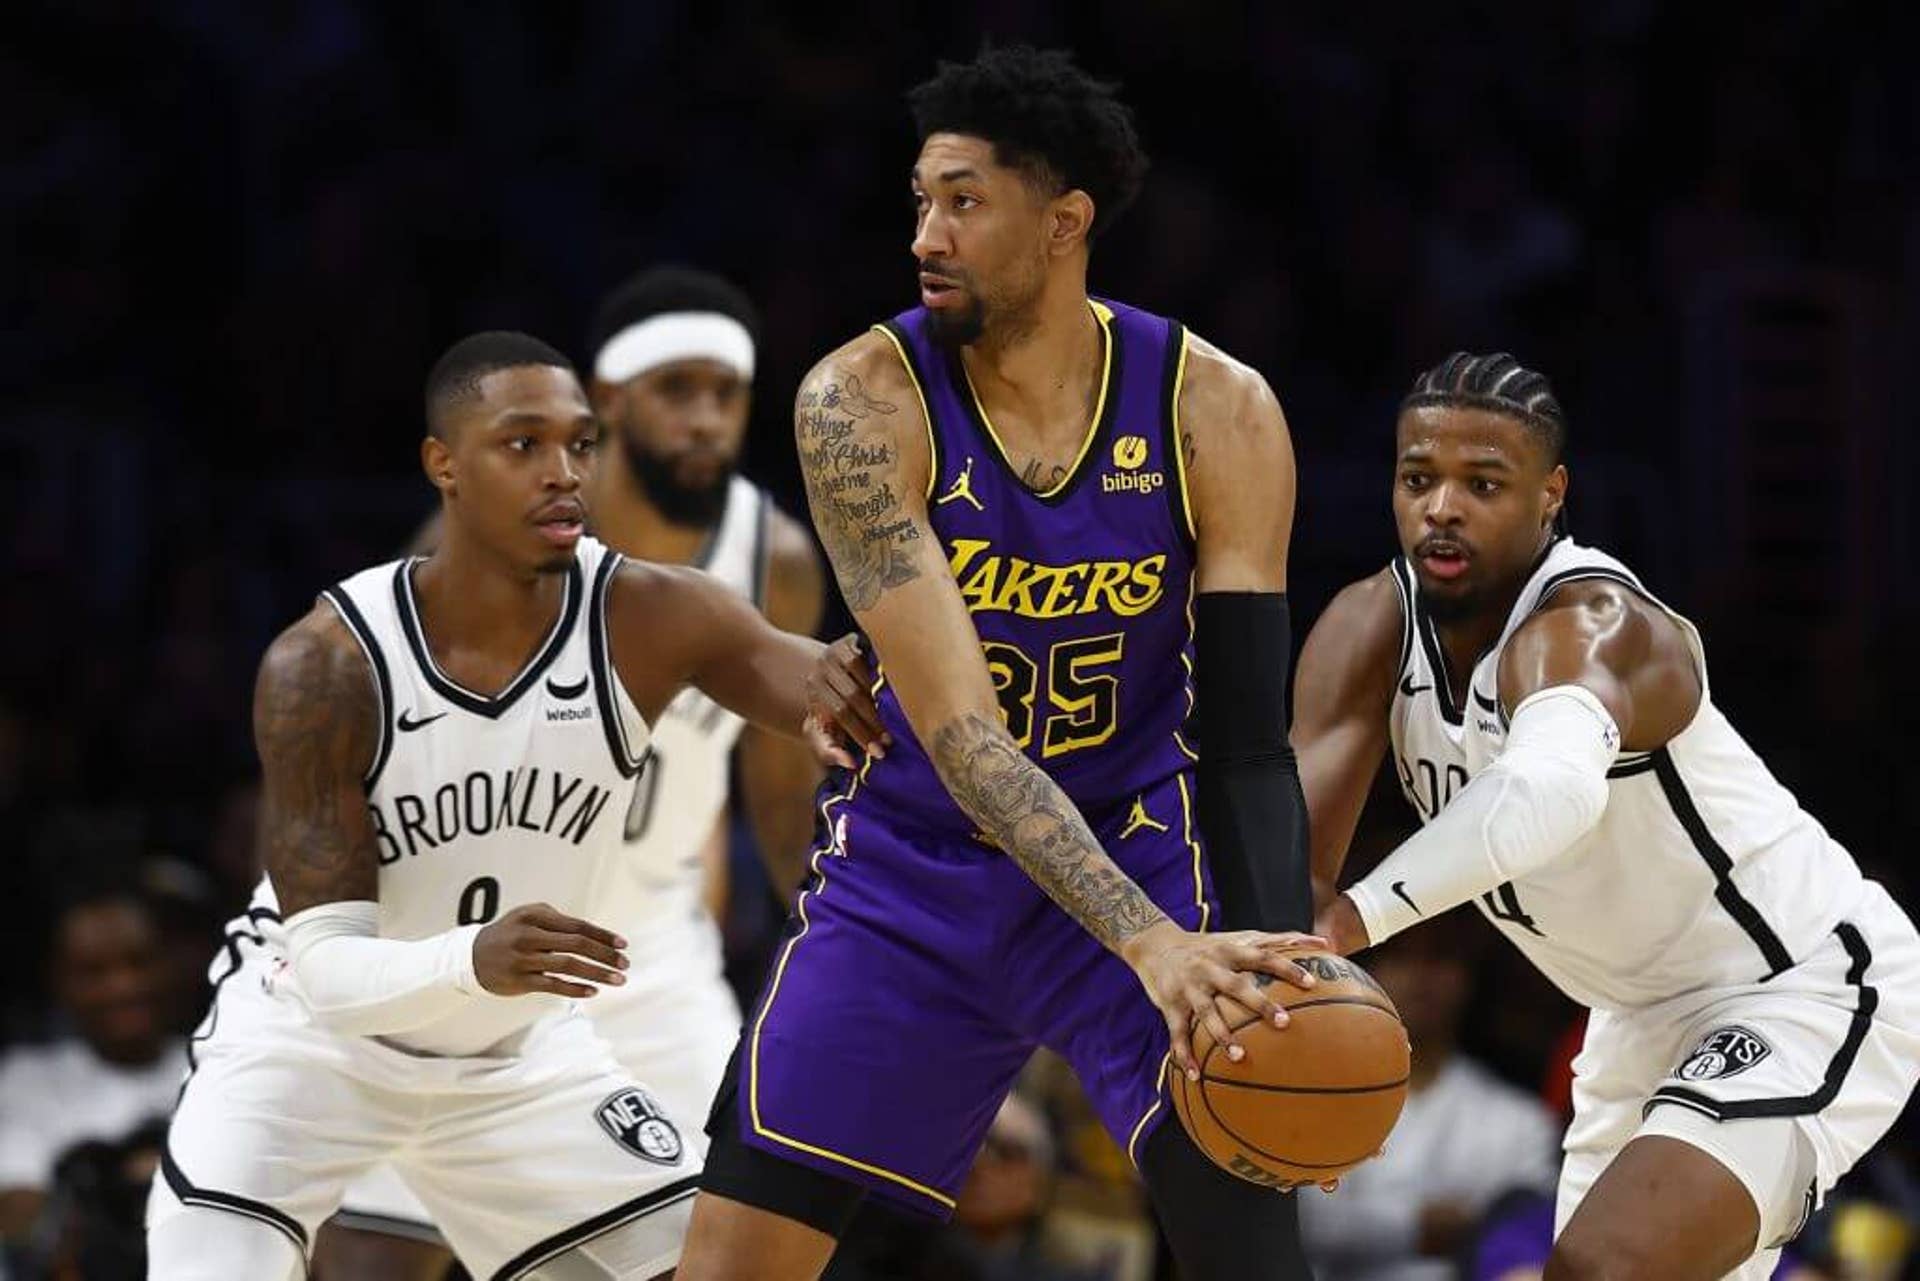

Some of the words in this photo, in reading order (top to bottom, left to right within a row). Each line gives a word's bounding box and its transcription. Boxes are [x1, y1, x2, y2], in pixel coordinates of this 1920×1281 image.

[1102, 470, 1164, 494] bibigo
[546, 706, 593, 721] Webull
[368, 767, 611, 866] BROOKLYN
